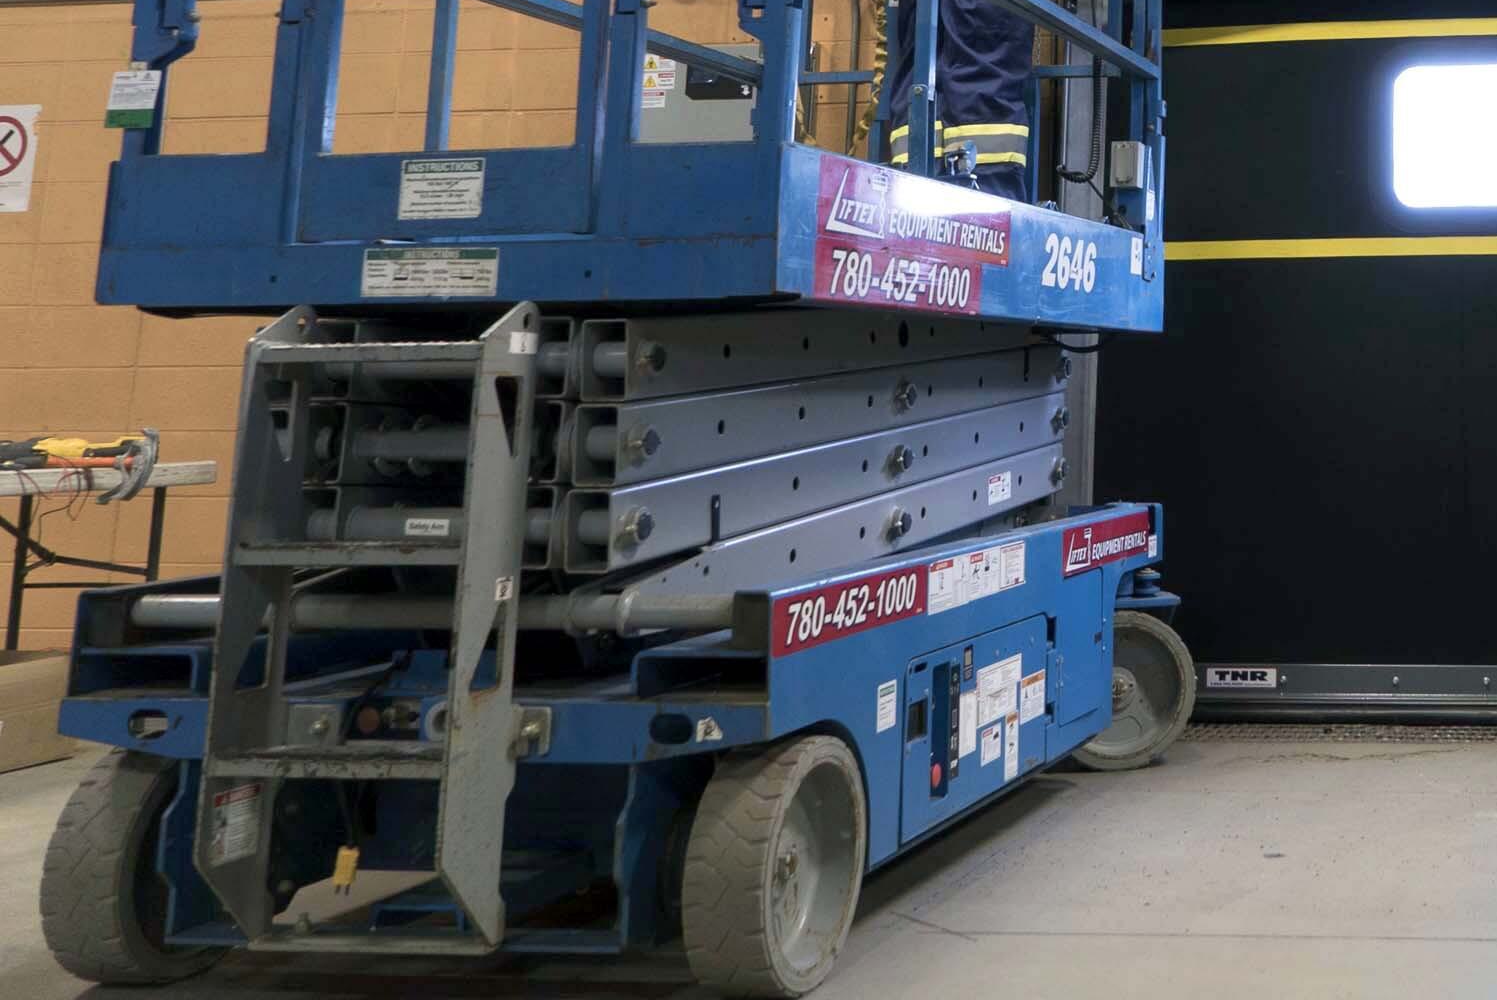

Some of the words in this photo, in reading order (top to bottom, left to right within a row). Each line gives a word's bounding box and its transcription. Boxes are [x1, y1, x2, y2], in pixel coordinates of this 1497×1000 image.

[406, 161, 479, 173] INSTRUCTIONS
[889, 211, 961, 246] EQUIPMENT
[960, 223, 1006, 255] RENTALS
[830, 249, 971, 308] 780-452-1000
[1041, 232, 1097, 294] 2646
[1065, 531, 1091, 572] LIFTEX
[1092, 536, 1125, 561] EQUIPMENT
[1124, 530, 1147, 551] RENTALS
[786, 572, 917, 646] 780-452-1000
[1214, 670, 1268, 681] TNR
